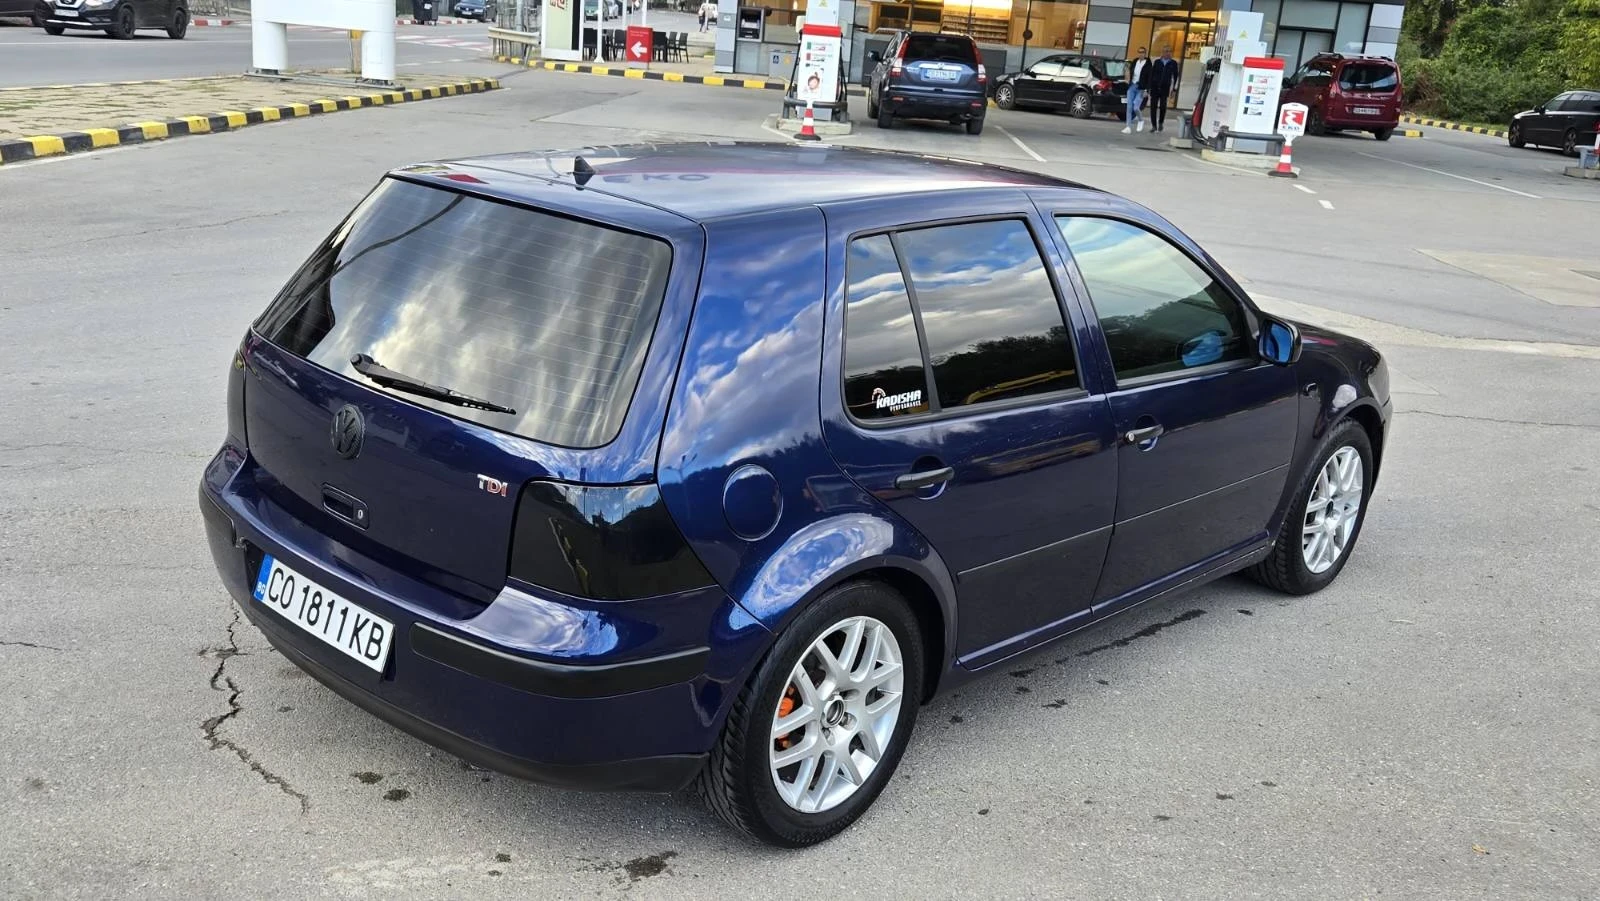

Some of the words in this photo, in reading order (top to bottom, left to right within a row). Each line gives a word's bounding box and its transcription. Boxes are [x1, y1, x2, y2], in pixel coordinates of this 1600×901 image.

[876, 390, 921, 409] KADISHA
[477, 473, 508, 497] TDI
[298, 585, 349, 642] 1811
[349, 613, 384, 660] KB
